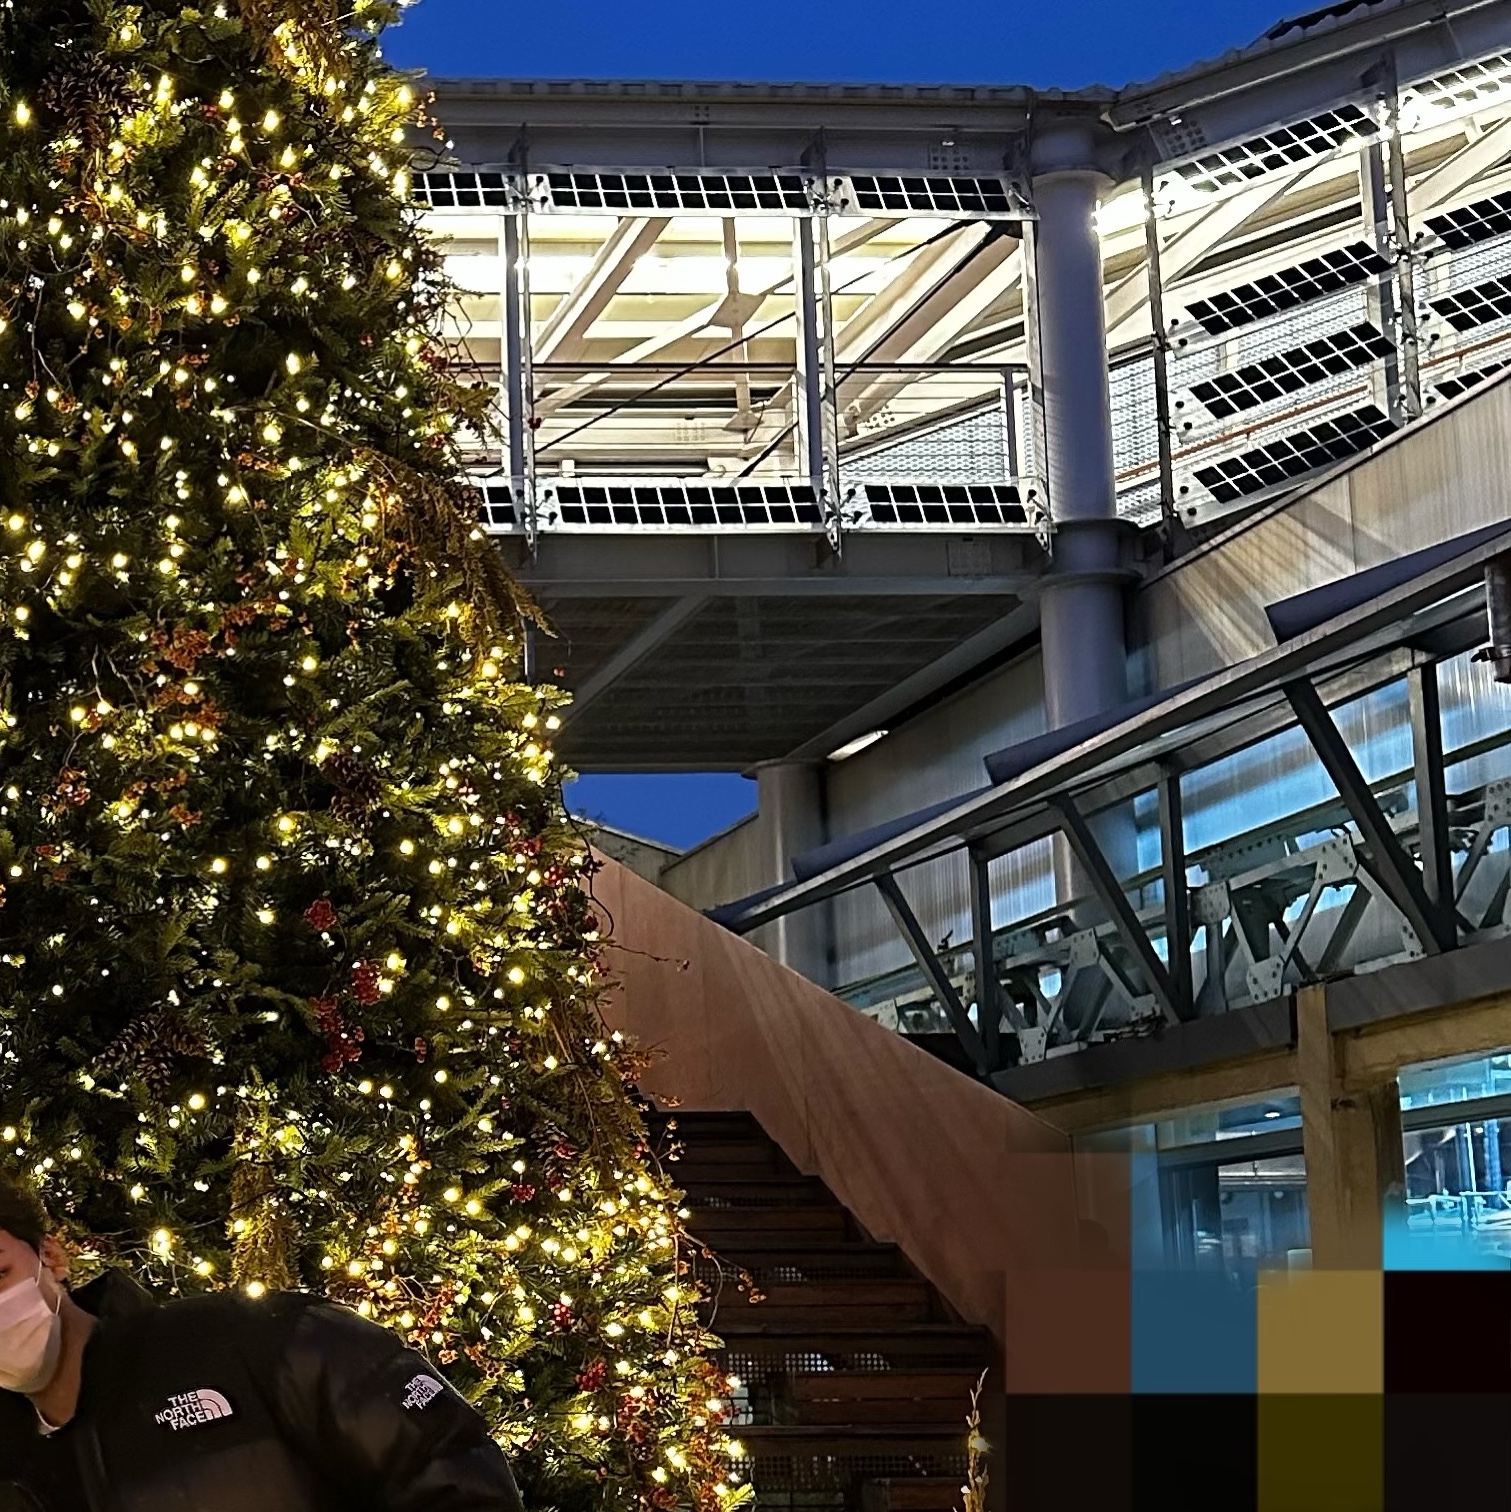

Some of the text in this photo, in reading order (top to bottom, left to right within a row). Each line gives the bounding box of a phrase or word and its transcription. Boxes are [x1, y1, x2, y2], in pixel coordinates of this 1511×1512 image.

[167, 1391, 198, 1407] THE
[154, 1401, 202, 1424] NORTH
[170, 1410, 206, 1431] FACE
